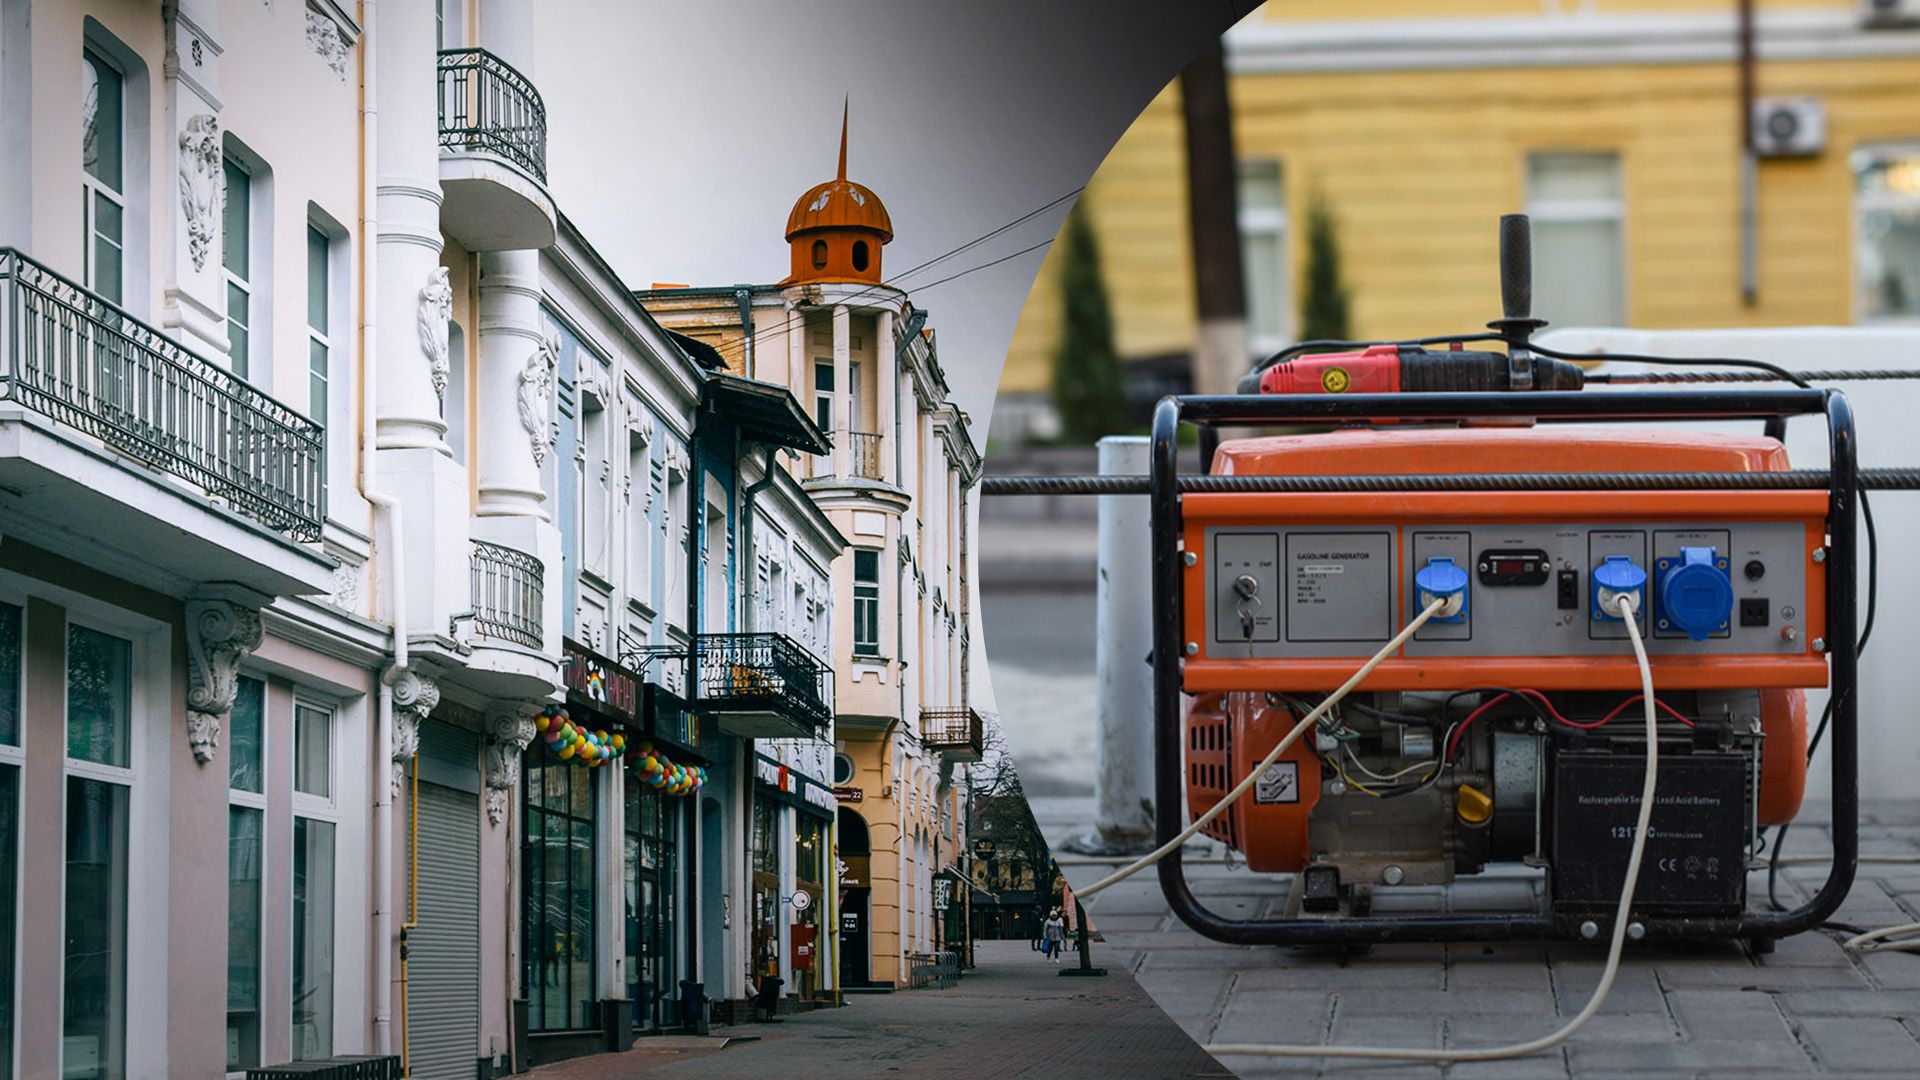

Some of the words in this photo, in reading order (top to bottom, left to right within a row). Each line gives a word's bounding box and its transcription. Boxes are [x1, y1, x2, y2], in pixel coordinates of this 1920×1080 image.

[1297, 552, 1329, 560] GASOLINE
[1331, 552, 1370, 560] GENERATOR
[852, 791, 862, 799] 22
[1578, 795, 1629, 806] Rechargeable
[1656, 796, 1673, 805] Lead
[1676, 796, 1692, 805] Acid
[1693, 796, 1720, 807] Battery
